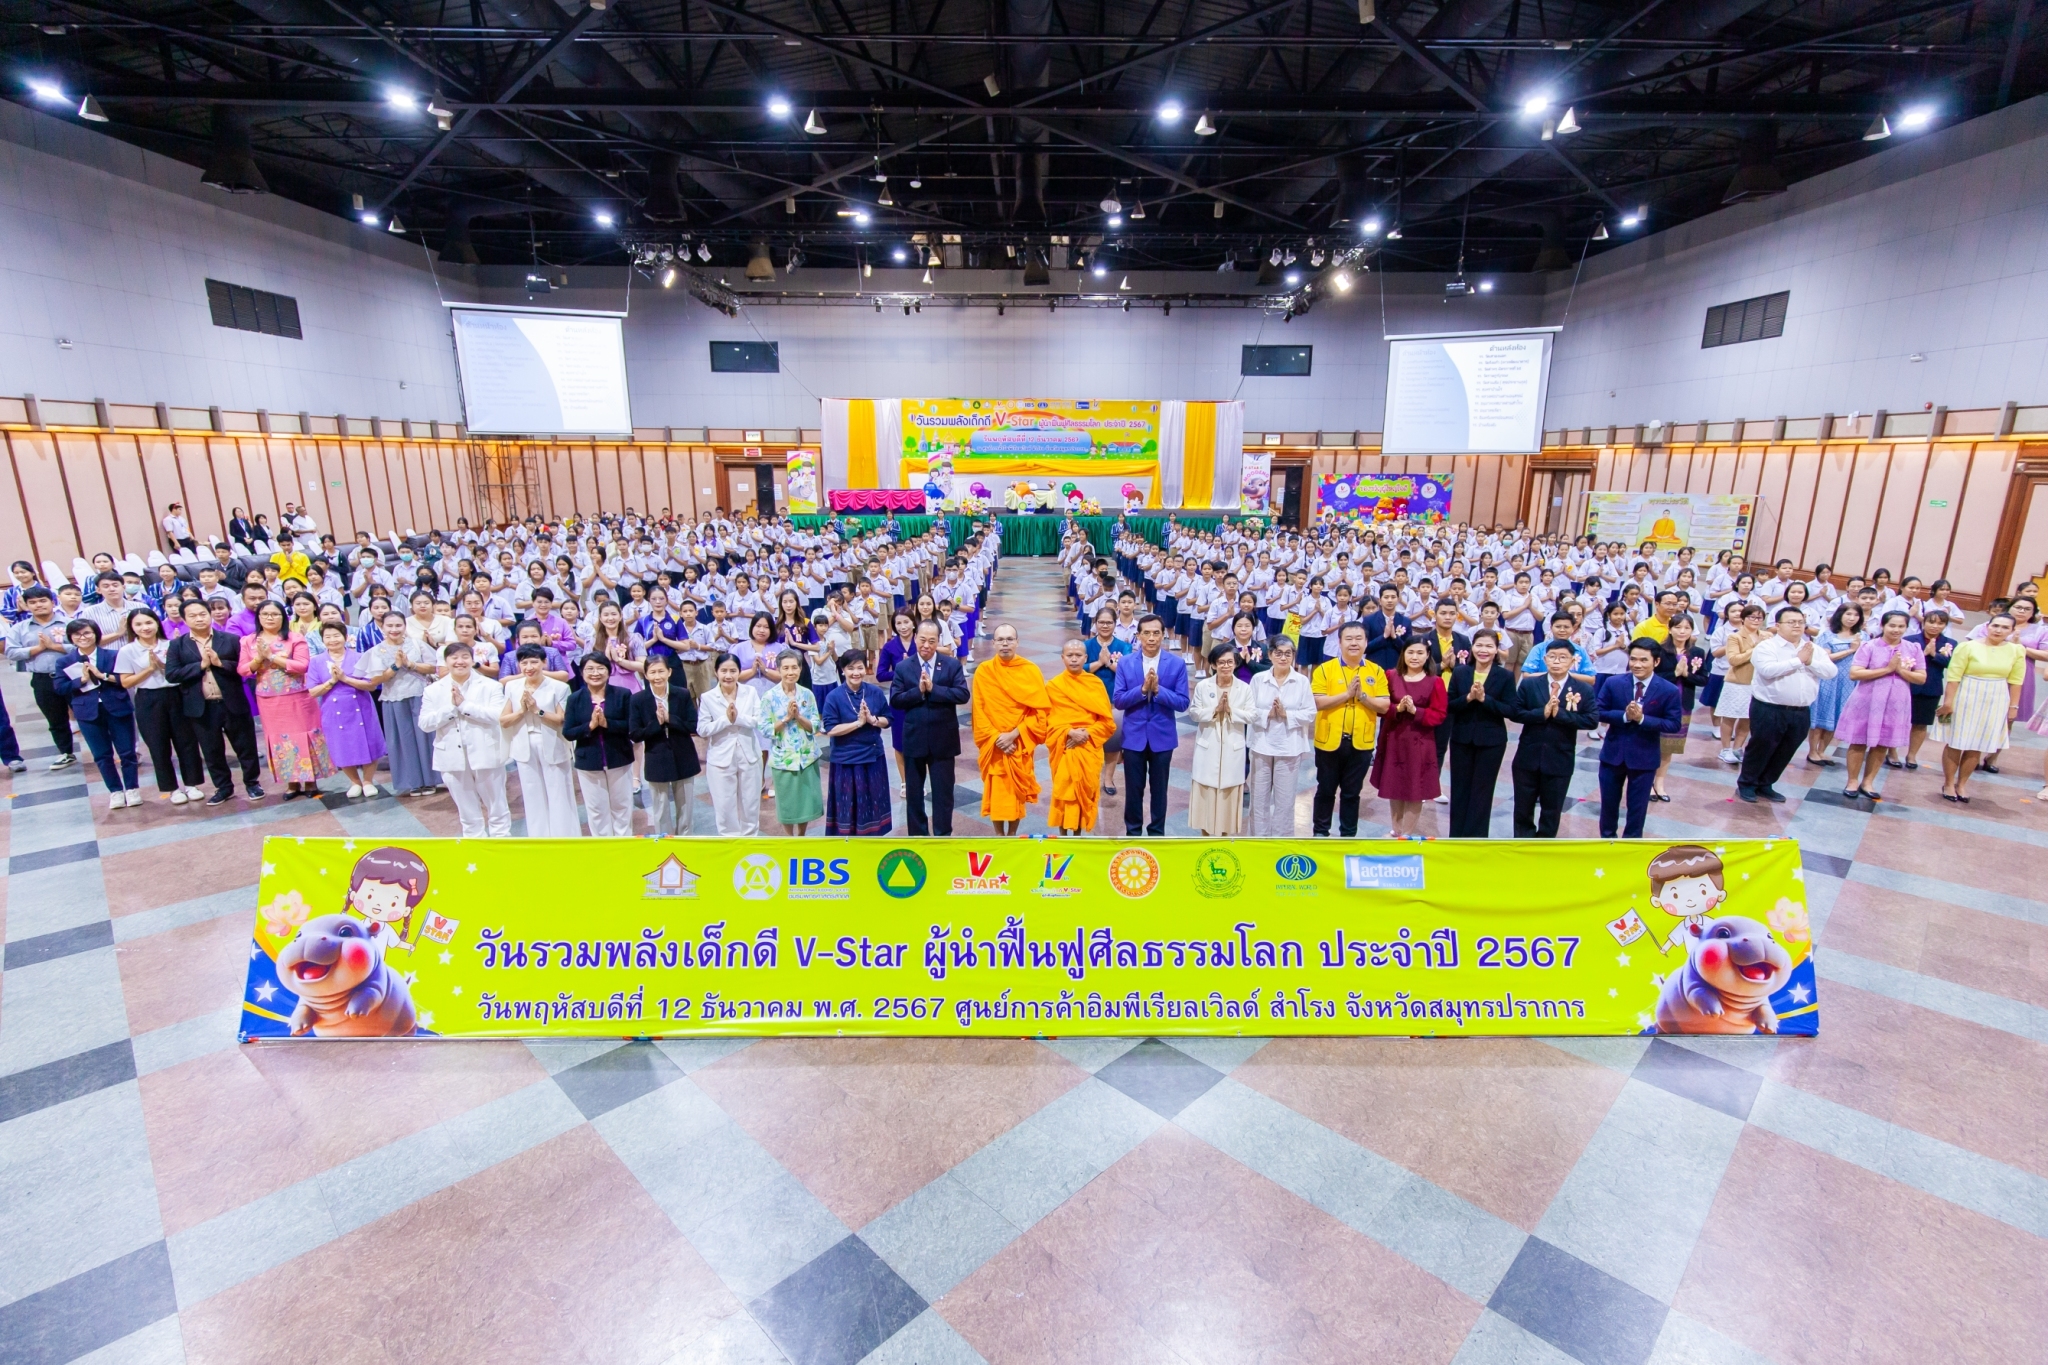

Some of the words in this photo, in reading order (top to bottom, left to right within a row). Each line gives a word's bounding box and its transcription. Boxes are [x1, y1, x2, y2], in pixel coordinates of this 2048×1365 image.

[916, 414, 991, 426] วันรวมพลังเด็กดี
[995, 412, 1035, 426] V-Star
[789, 858, 850, 886] IBS
[968, 851, 993, 878] V
[1349, 857, 1420, 887] Lactasoy
[953, 878, 1000, 889] STAR
[424, 924, 450, 941] STAR
[434, 916, 448, 930] V
[1613, 918, 1627, 931] V
[1618, 922, 1641, 942] STAR
[476, 921, 780, 969] วันรวมพลังเด็กดี
[794, 935, 909, 969] V-Star
[923, 915, 1302, 980] ผู้นำฟื้นฟูศีลธรรมโลก
[1320, 928, 1459, 968] ประจำปี
[1476, 936, 1581, 969] 2567
[477, 985, 644, 1026] วันพฤหัสบดีที่
[657, 998, 692, 1020] 12
[701, 991, 803, 1020] ธันวาคม
[814, 997, 863, 1020] พ.ศ.
[873, 998, 946, 1020] 2567
[955, 988, 1262, 1027] ศูนย์การค้าอิมพีเรียลเวิลด์
[1270, 987, 1336, 1020] สำโรง
[1345, 991, 1586, 1027] จังหวัดสมุทรปราการ
